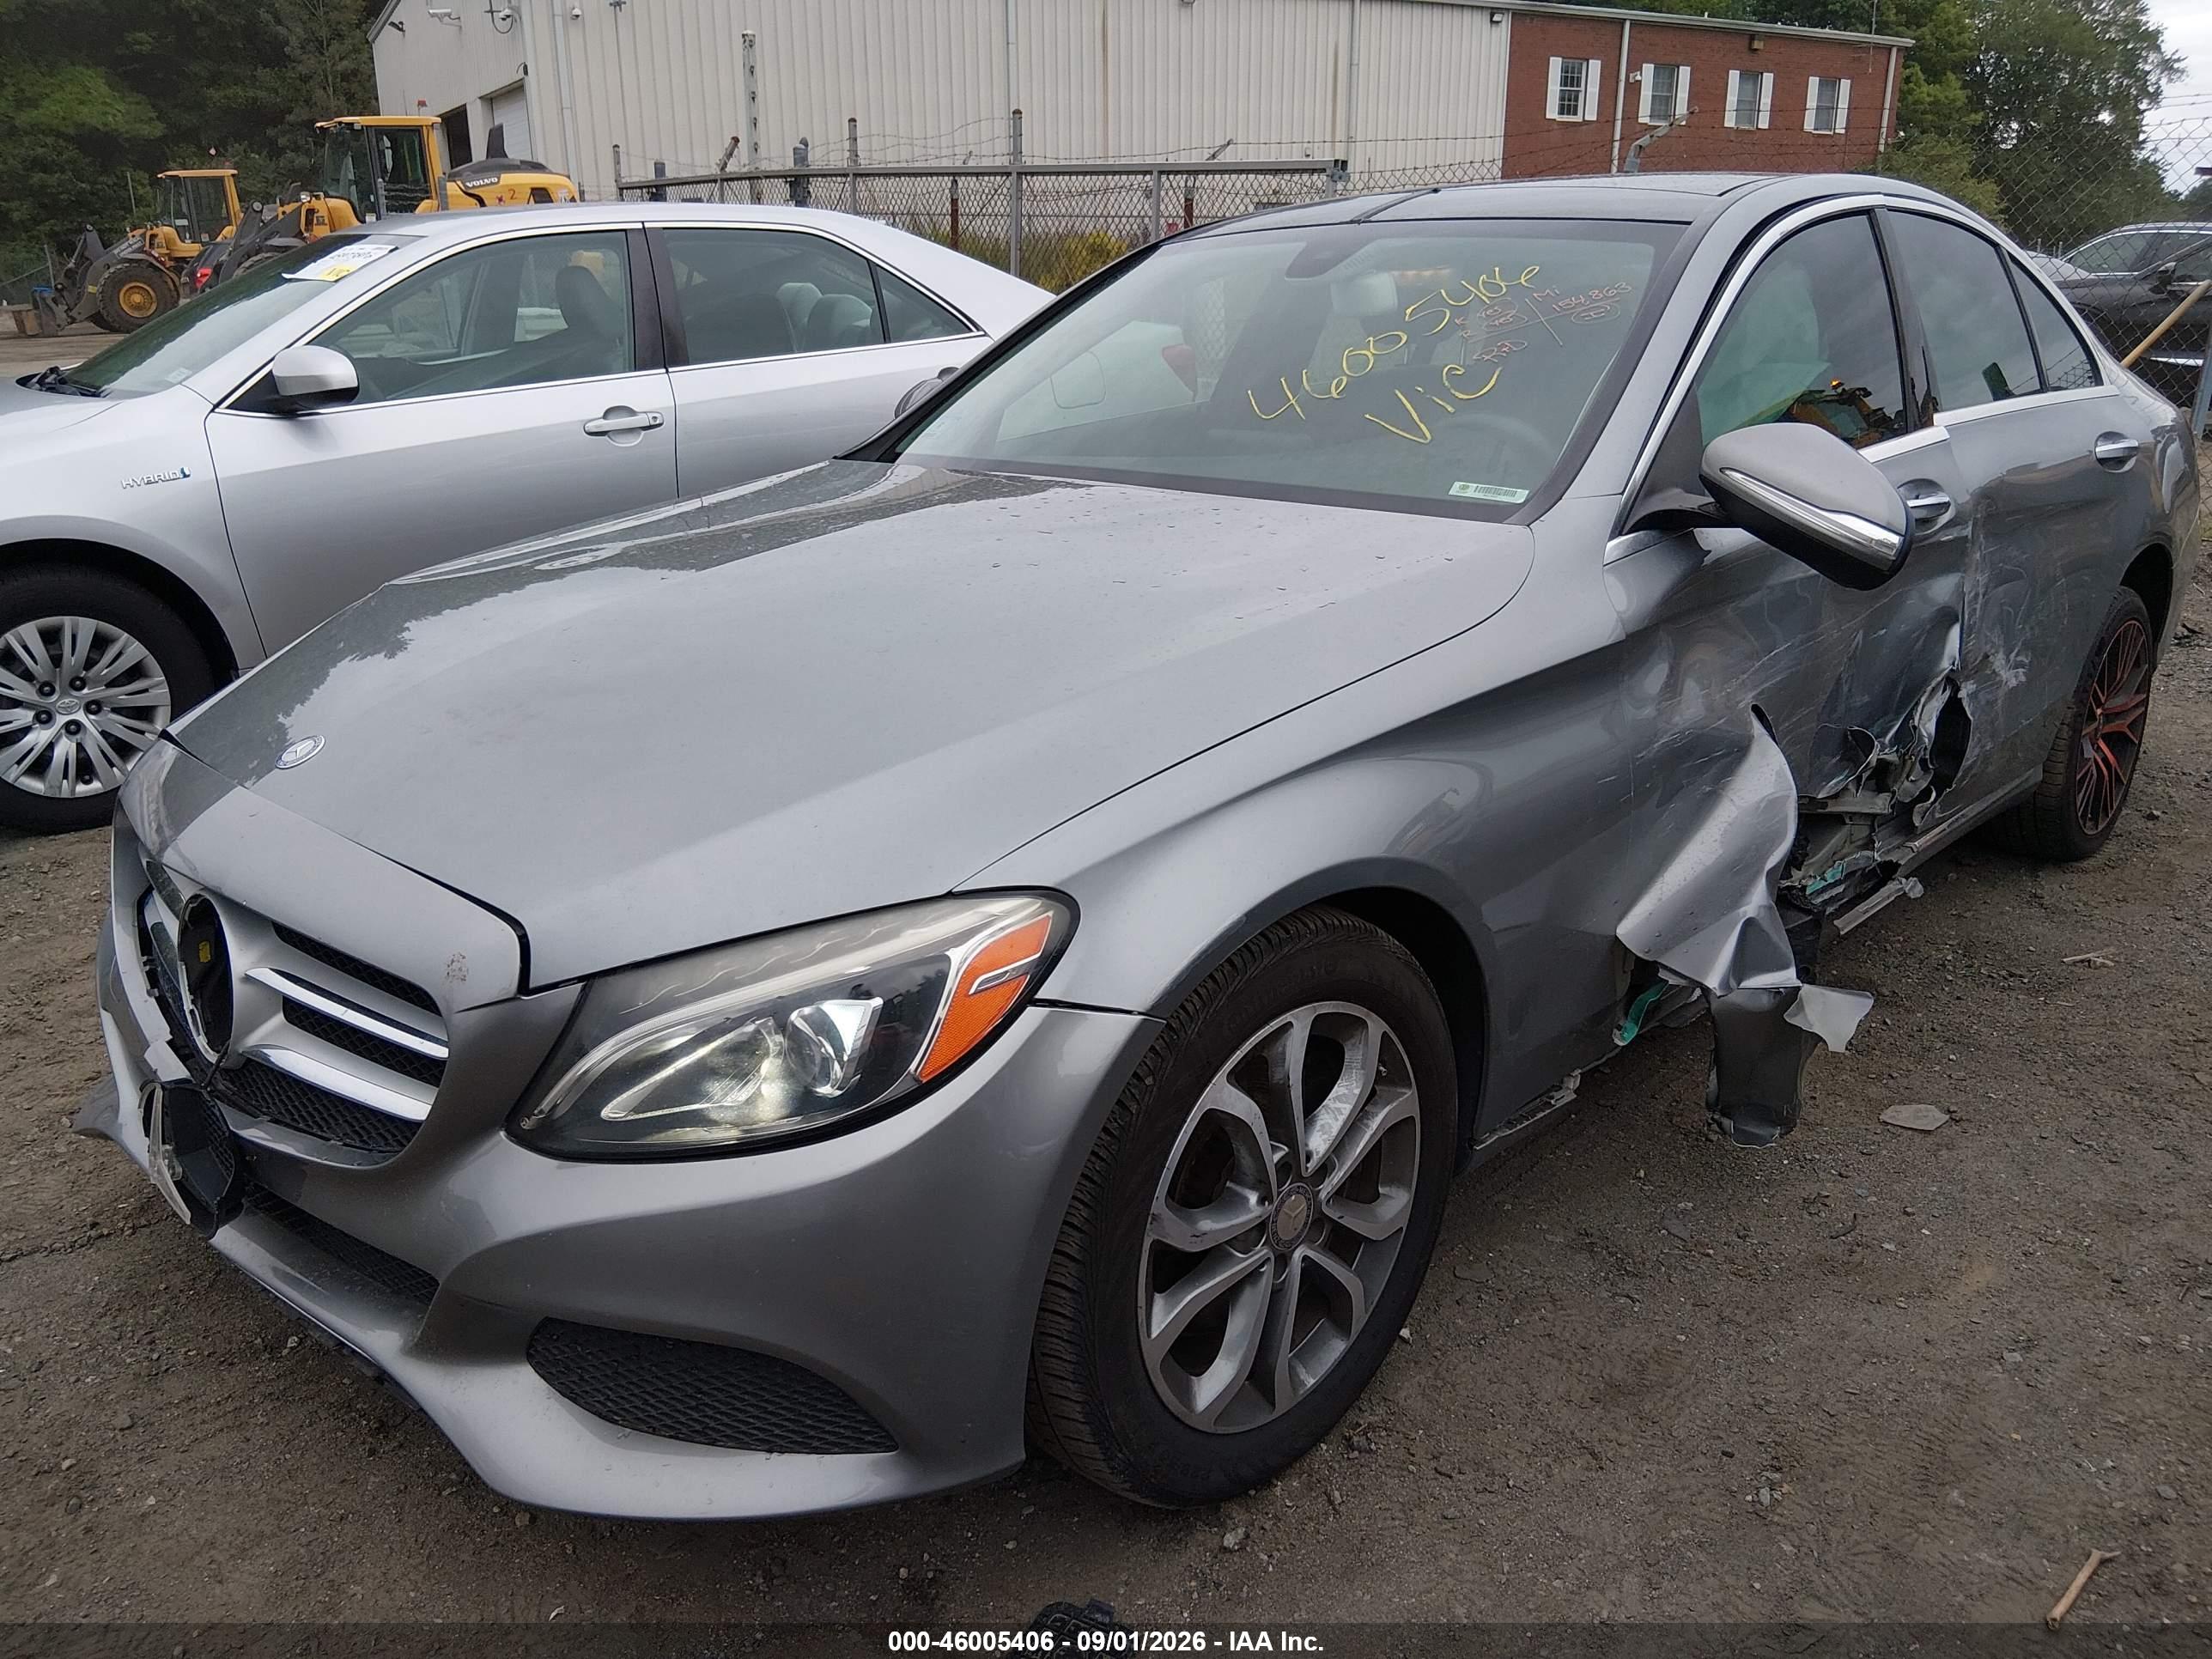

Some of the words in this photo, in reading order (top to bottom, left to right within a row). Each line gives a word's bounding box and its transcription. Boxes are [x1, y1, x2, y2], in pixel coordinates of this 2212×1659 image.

[465, 177, 498, 187] VOLVO
[507, 188, 518, 200] 2
[121, 471, 179, 489] HYBRID
